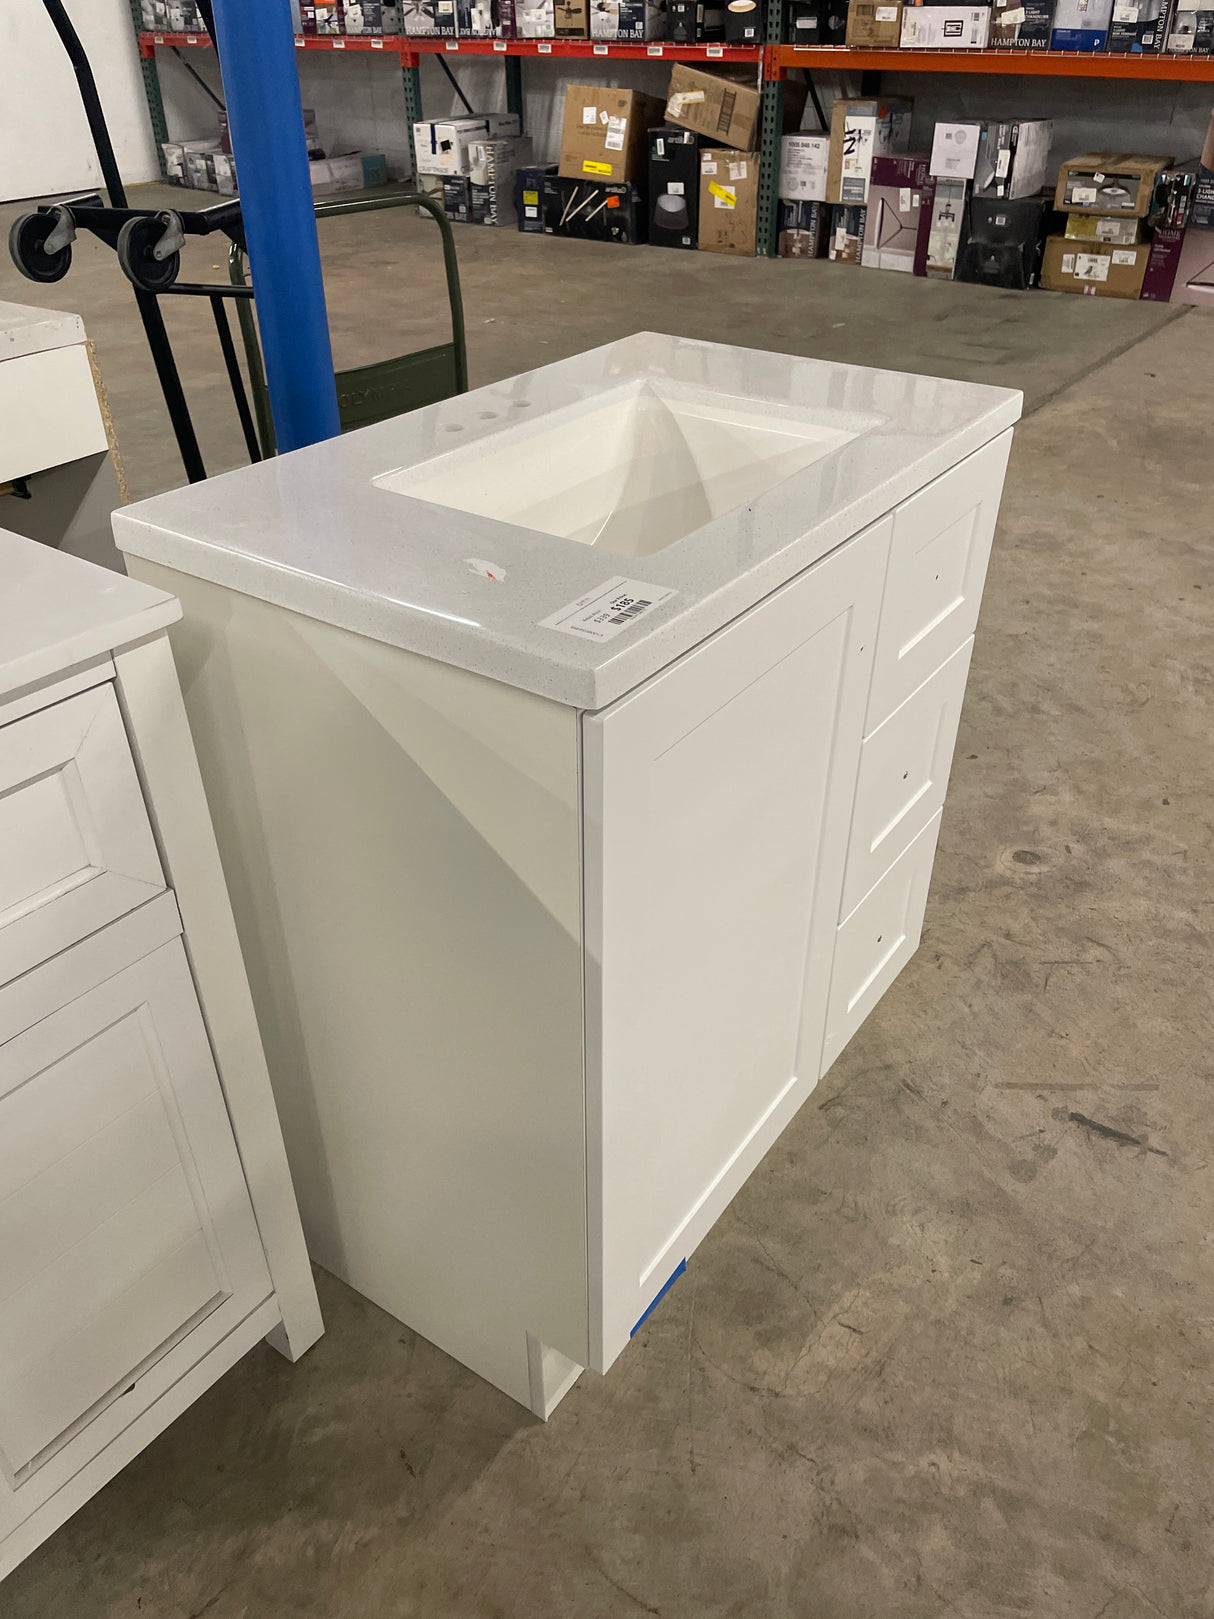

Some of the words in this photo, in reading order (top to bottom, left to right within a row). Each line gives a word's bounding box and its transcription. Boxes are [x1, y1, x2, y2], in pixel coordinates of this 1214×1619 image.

[1156, 0, 1169, 32] MPTON
[405, 26, 440, 35] HAMPTON
[441, 26, 455, 36] BAY
[629, 29, 644, 39] BAY
[991, 37, 1031, 47] HAMPTON
[1031, 38, 1047, 48] BAY
[1153, 34, 1163, 49] BAY
[485, 146, 497, 204] HAMPTON
[855, 224, 865, 263] HAMPTON
[610, 598, 634, 611] $185
